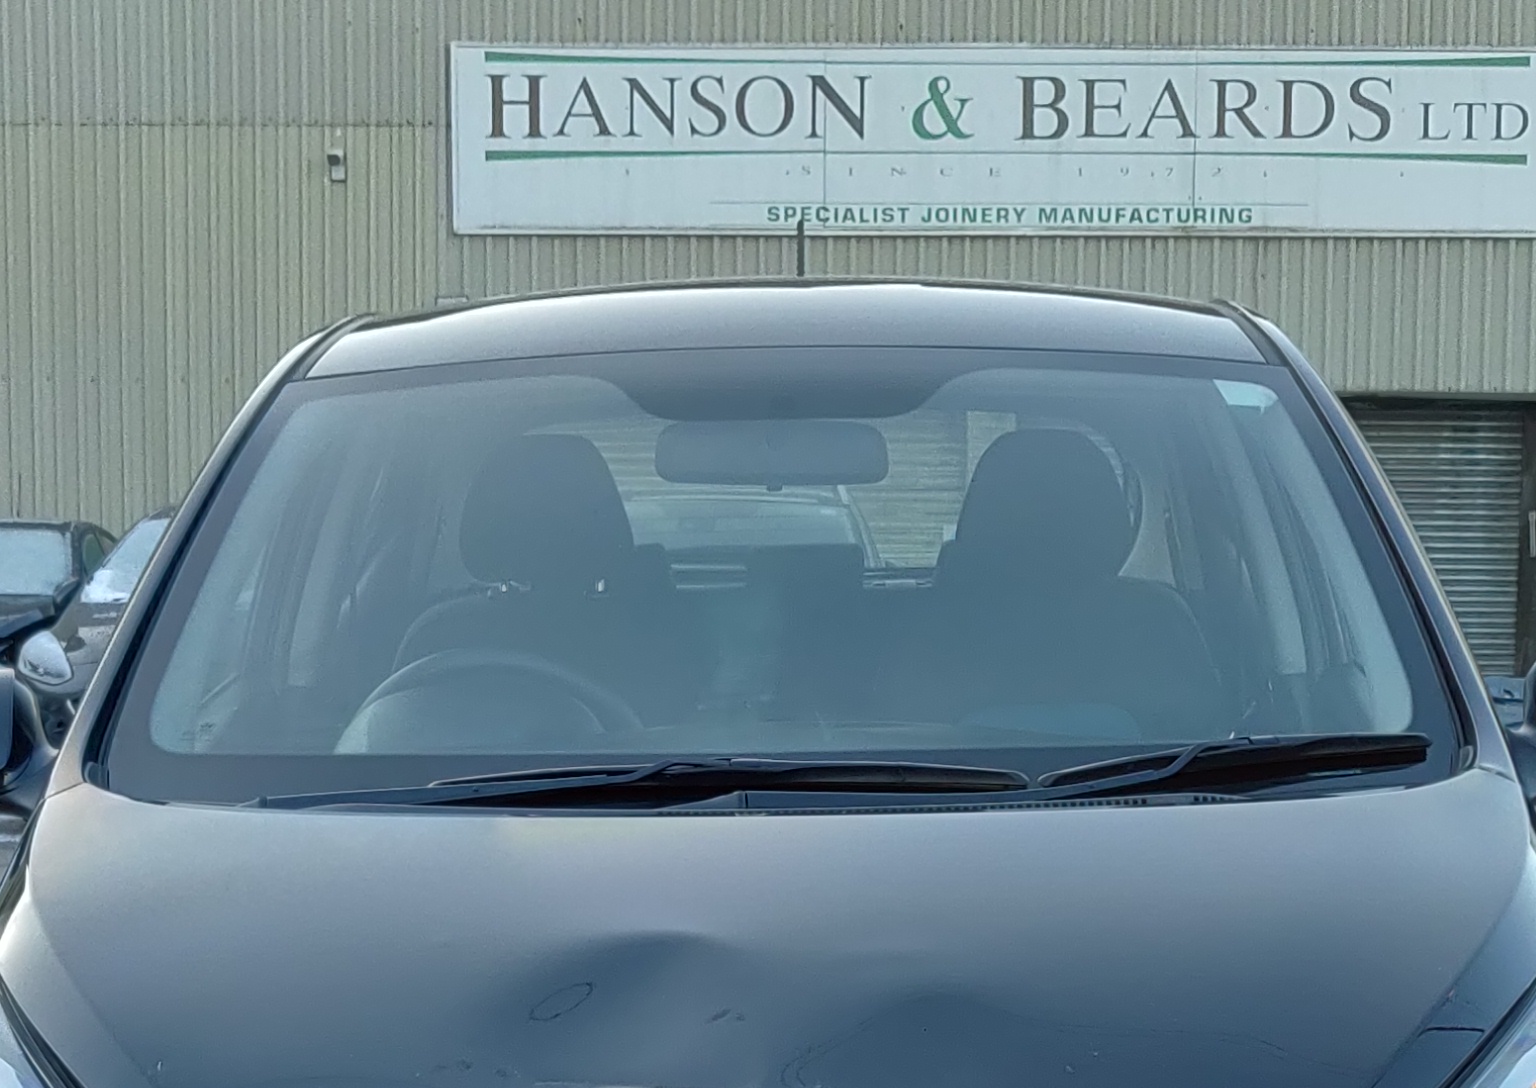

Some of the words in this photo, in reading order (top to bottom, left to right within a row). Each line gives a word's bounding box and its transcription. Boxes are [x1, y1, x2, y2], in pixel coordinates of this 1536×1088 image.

[486, 74, 871, 140] HANSON
[911, 75, 974, 141] &
[1014, 75, 1392, 142] BEARDS
[1420, 102, 1529, 141] LTD
[767, 206, 910, 224] SPECIALIST
[920, 207, 1026, 224] JOINERY
[1038, 207, 1252, 224] MANUFACTURING
